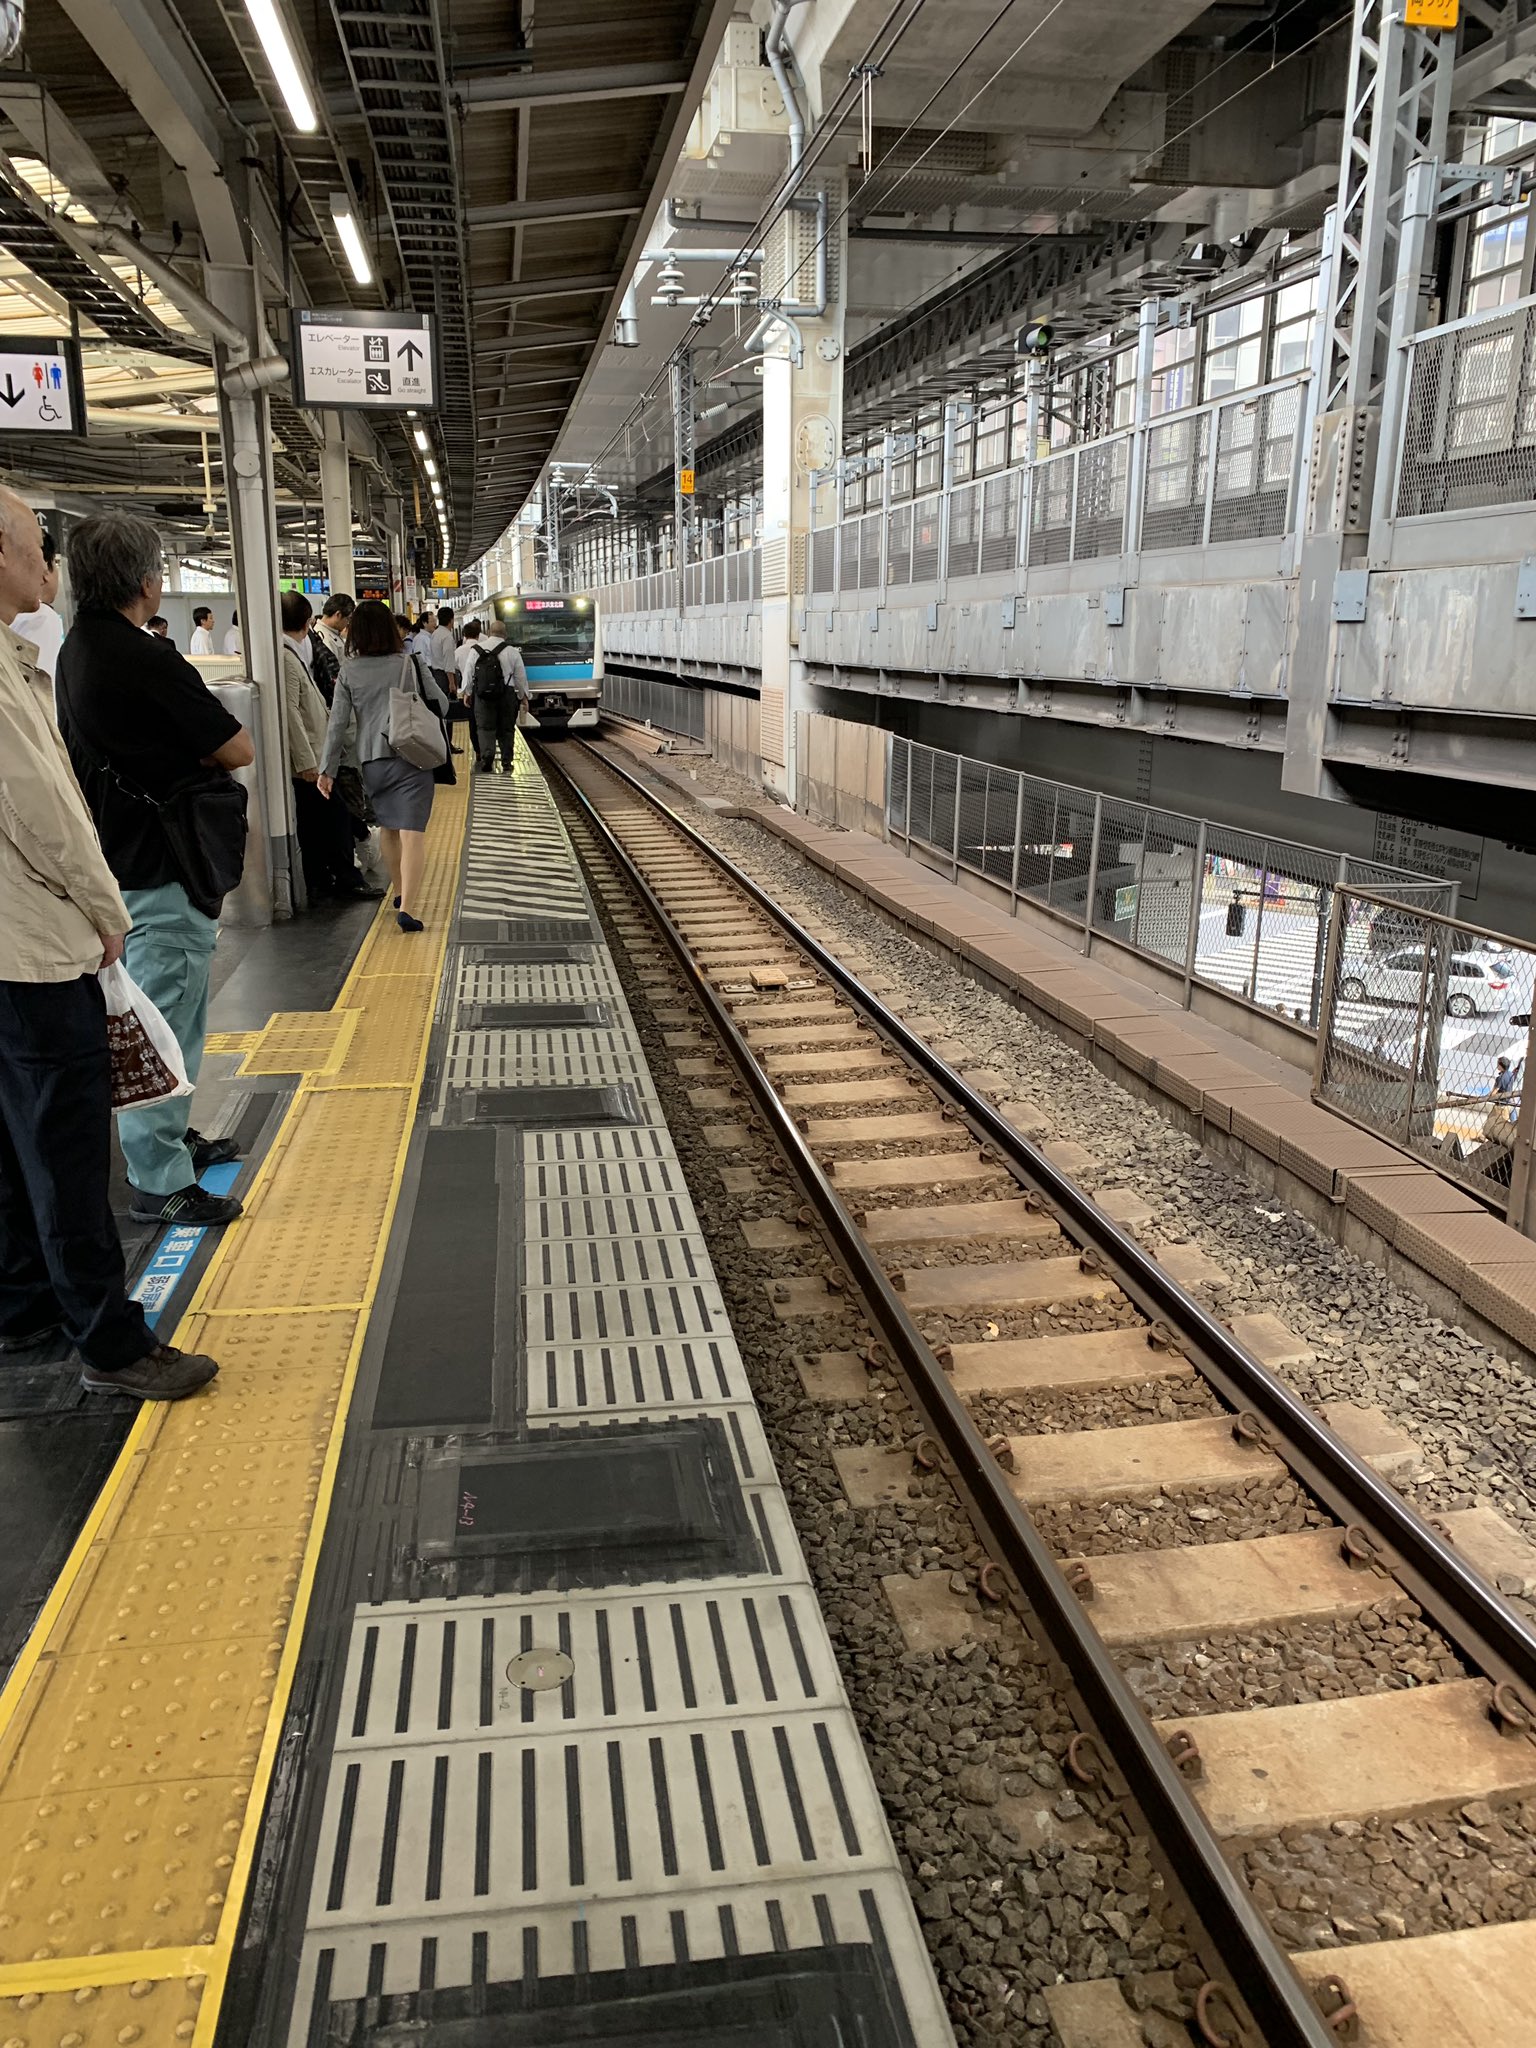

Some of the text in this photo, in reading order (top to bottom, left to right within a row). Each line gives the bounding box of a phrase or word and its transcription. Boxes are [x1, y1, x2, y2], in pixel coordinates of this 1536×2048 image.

[308, 333, 360, 343] エレベーター
[309, 366, 362, 376] エスカレーター
[402, 377, 421, 386] 直進
[407, 387, 427, 395] straight
[682, 474, 693, 485] 14
[153, 1226, 203, 1268] 乗車口
[138, 1275, 171, 1311] 弱冷房車
